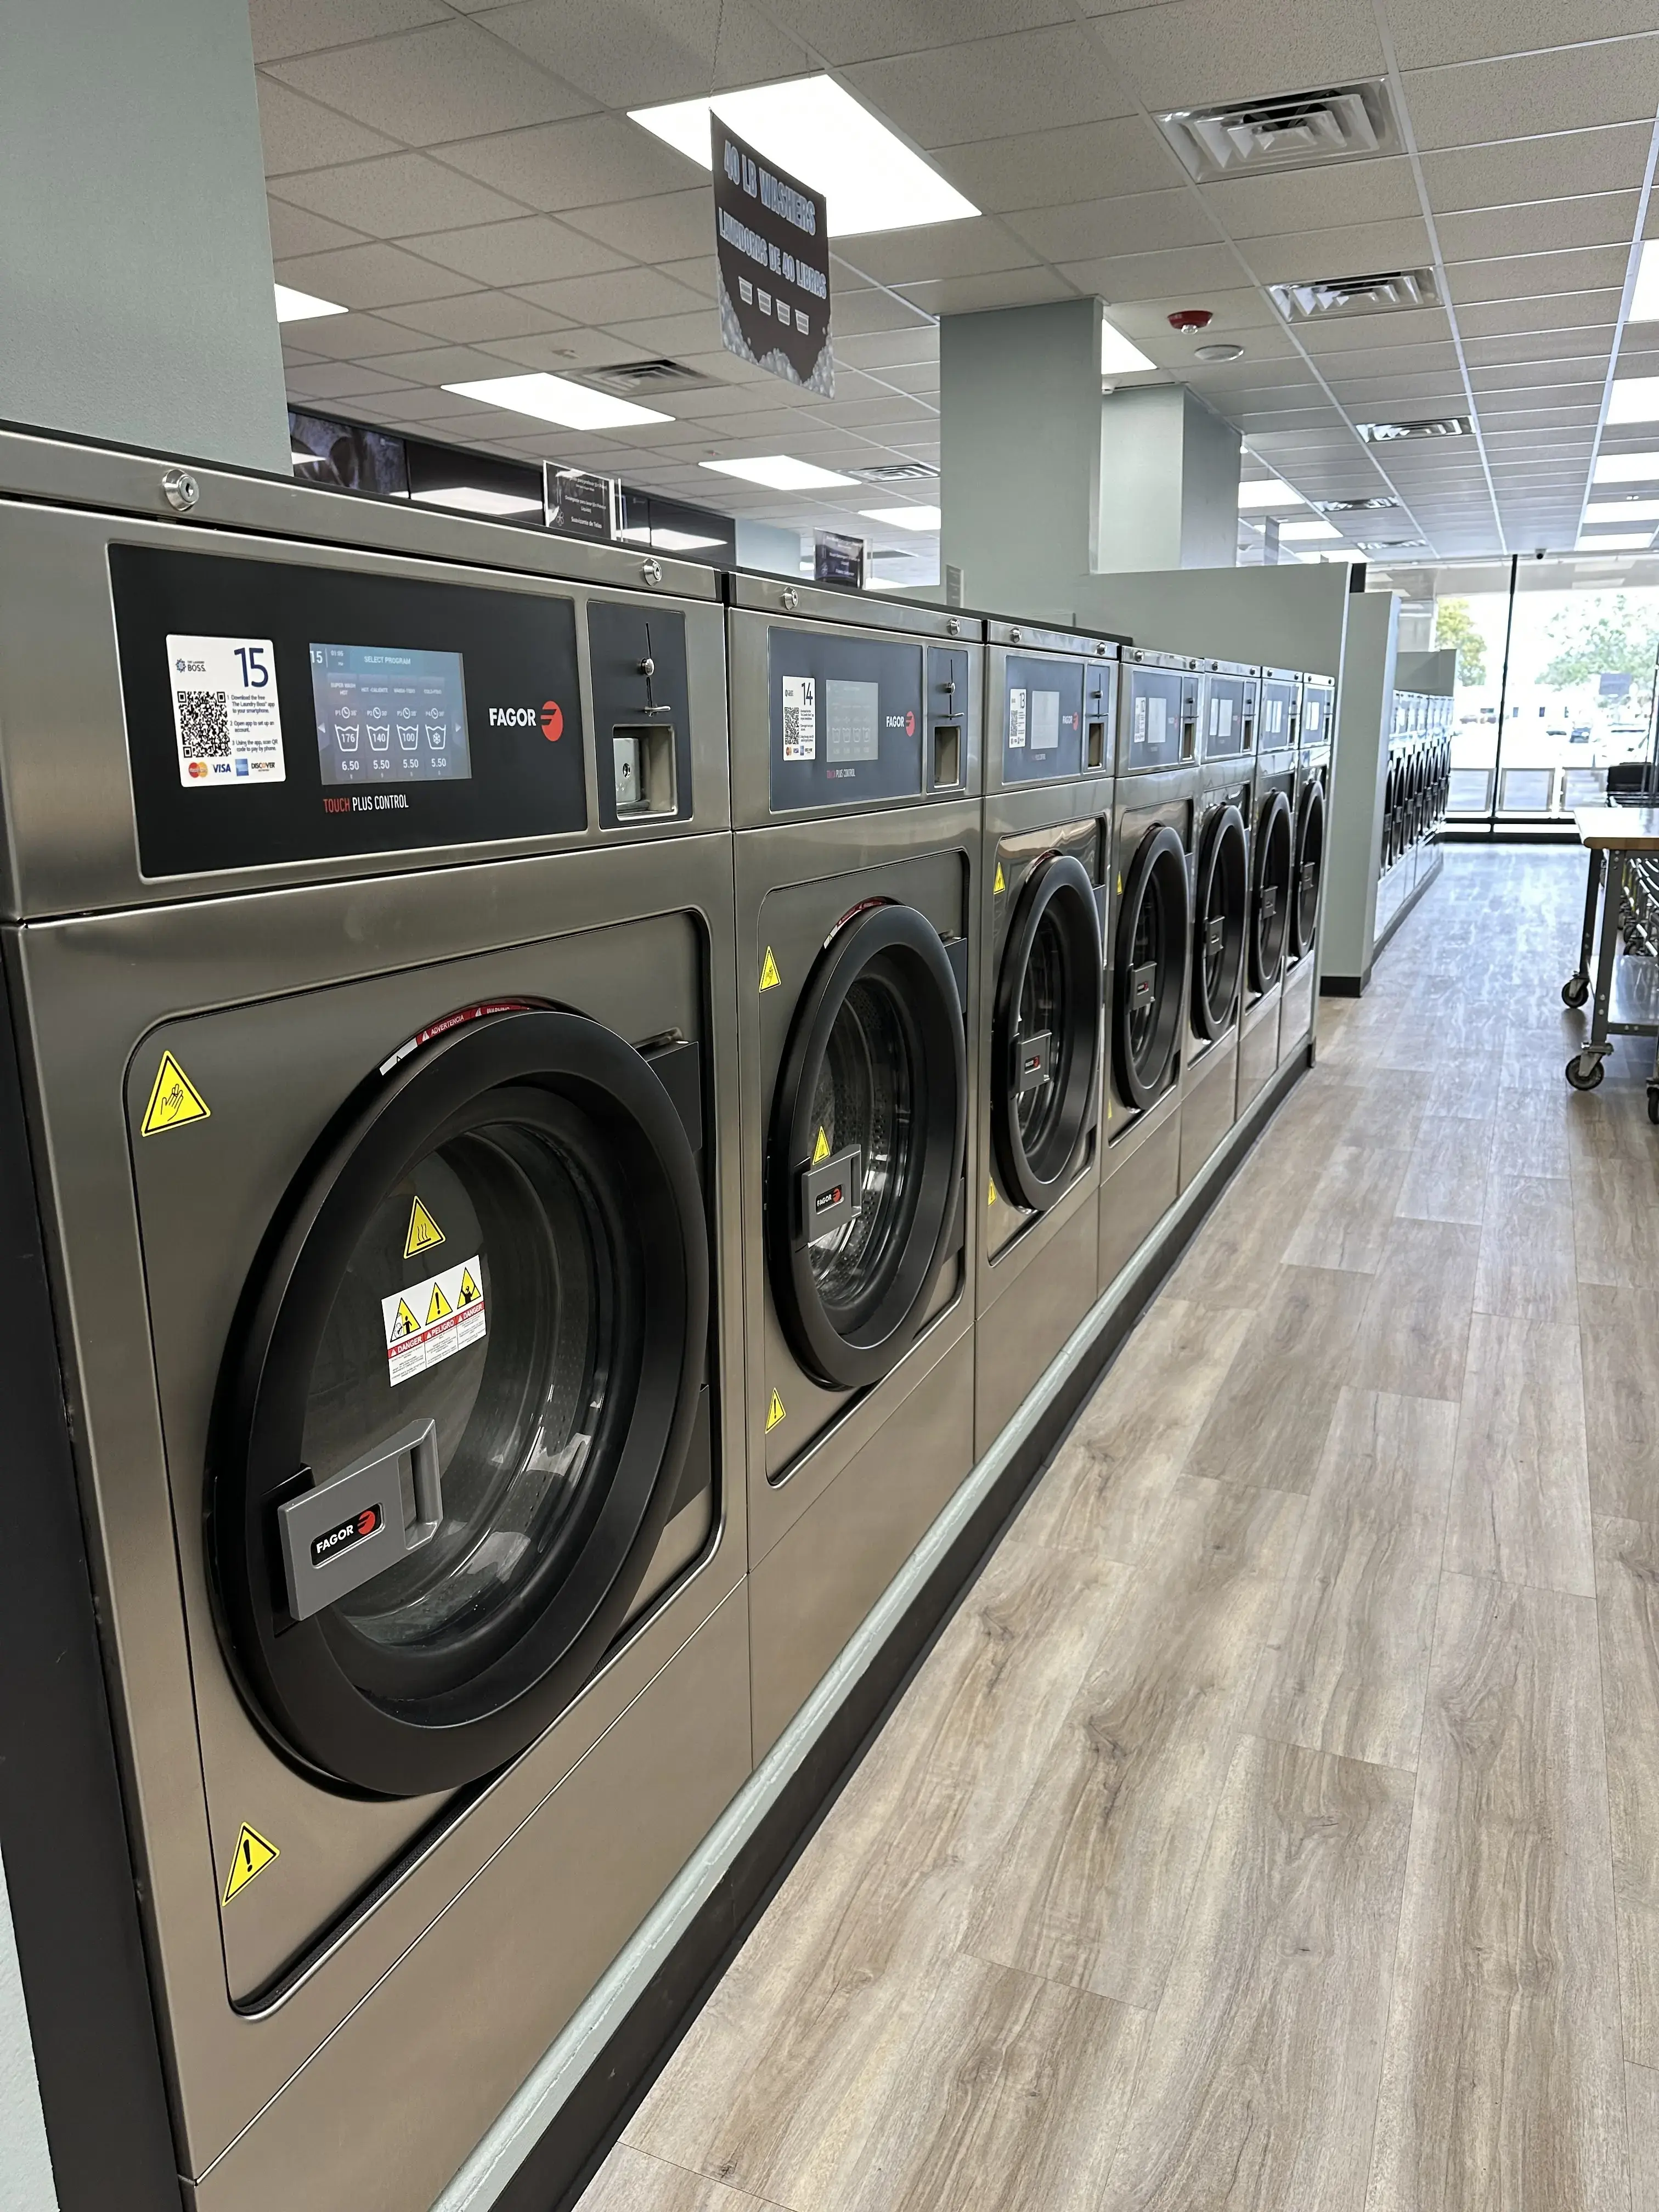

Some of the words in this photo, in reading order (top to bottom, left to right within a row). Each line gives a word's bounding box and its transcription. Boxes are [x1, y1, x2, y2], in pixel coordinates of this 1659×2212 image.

[724, 140, 740, 185] 40
[742, 154, 758, 198] LB
[759, 167, 816, 235] WASHERS
[769, 242, 781, 275] DE
[782, 252, 795, 283] 40
[310, 651, 323, 663] 15
[234, 647, 268, 687] 15
[801, 682, 813, 706] 14
[489, 708, 537, 727] FAGOR
[886, 716, 905, 727] FAGOR
[341, 733, 355, 743] 176
[373, 733, 386, 743] 140
[403, 732, 415, 742] 100
[212, 763, 232, 773] VISA
[342, 760, 359, 770] 6.50
[373, 760, 390, 769] 5.50
[403, 759, 419, 768] 5.50
[431, 758, 447, 768] 5.50
[323, 798, 350, 813] TOUCH
[352, 796, 373, 811] PLUS
[375, 794, 409, 810] CONTROL
[431, 1015, 464, 1036] ADVERTENCIA
[817, 1194, 832, 1206] FAGOR
[463, 1304, 483, 1319] DANGER
[431, 1319, 455, 1336] PELIGRO
[398, 1336, 422, 1353] DANGER
[316, 1525, 354, 1554] FAGOR
